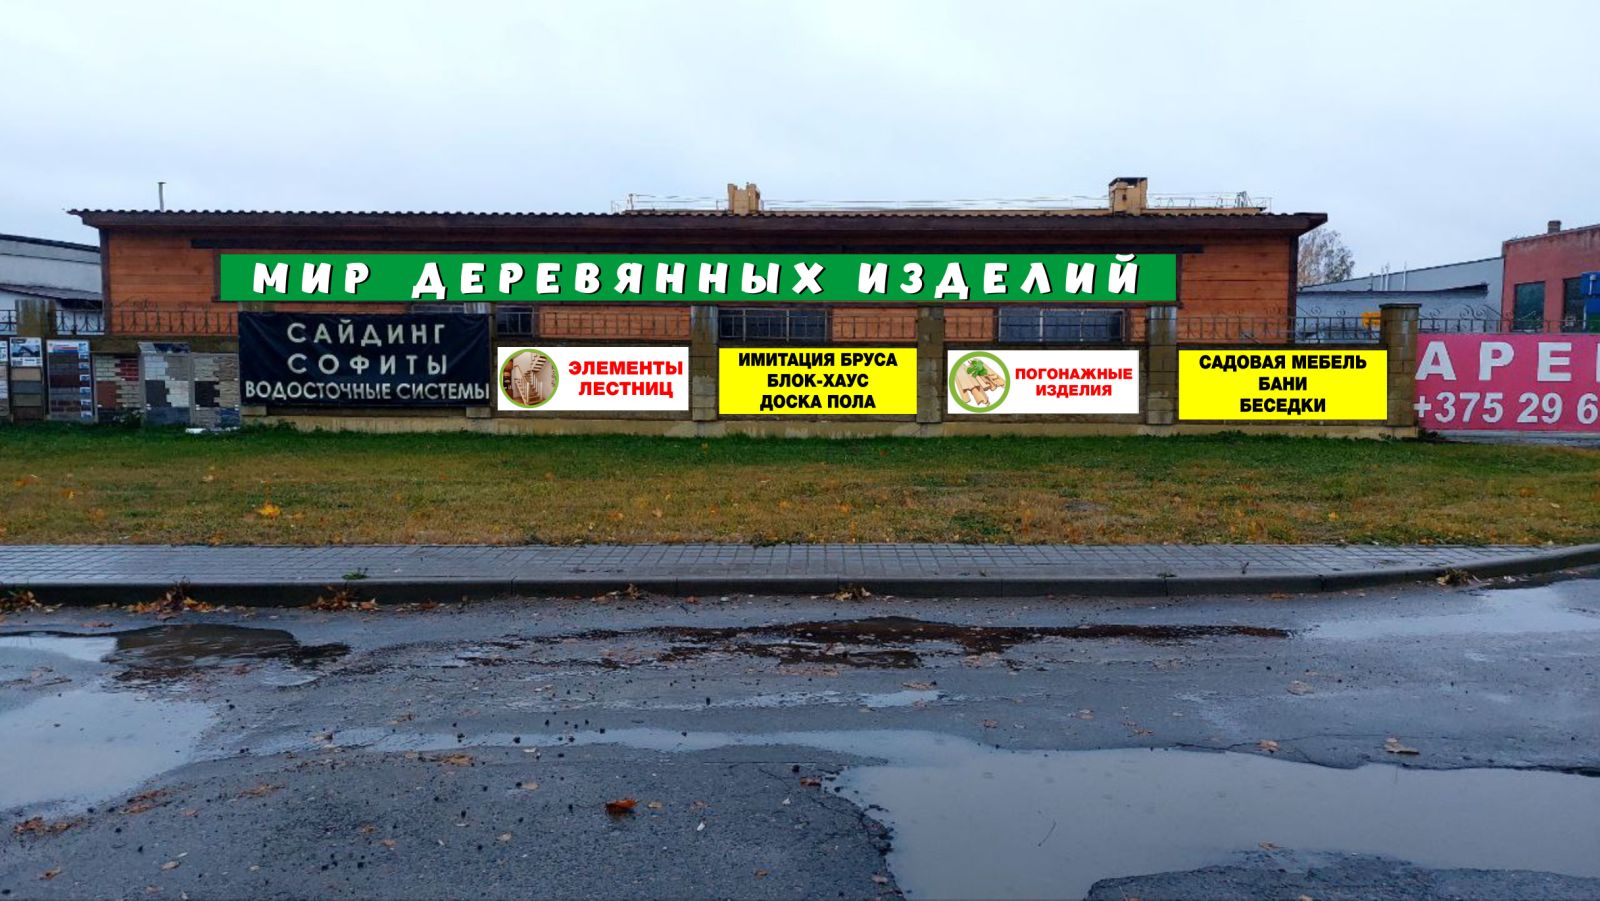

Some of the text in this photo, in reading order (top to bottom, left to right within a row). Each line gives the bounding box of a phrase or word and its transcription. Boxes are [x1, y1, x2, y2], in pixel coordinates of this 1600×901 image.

[252, 254, 1140, 300] МИР ДЕРЕВЯННЫХ ИЗДЕЛИЙ
[286, 319, 445, 347] САЙДИНГ
[287, 353, 447, 375] СОФИТЫ
[568, 360, 684, 376] ЭЛЕМЕНТЫ
[738, 352, 898, 370] ИМИТАЦИЯ БРУСА
[1199, 354, 1367, 373] САДОВАЯ МЕБЕЛЬ
[1414, 340, 1600, 383] АРЕ
[767, 373, 869, 388] БЛОК-ХАУС
[1015, 367, 1133, 380] ПОГОНАЖНЫЕ
[245, 380, 490, 401] ВОДОСТОЧНЫЕ СИСТЕМЫ
[578, 381, 674, 398] ЛЕСТНИЦ
[1035, 384, 1112, 399] ИЗДЕЛИЯ
[1258, 376, 1307, 391] БАНИ
[759, 394, 876, 411] ДОСКА ПОЛА
[1240, 397, 1326, 416] БЕСЕДКИ
[1413, 391, 1504, 424] +375
[1516, 391, 1563, 424] 29
